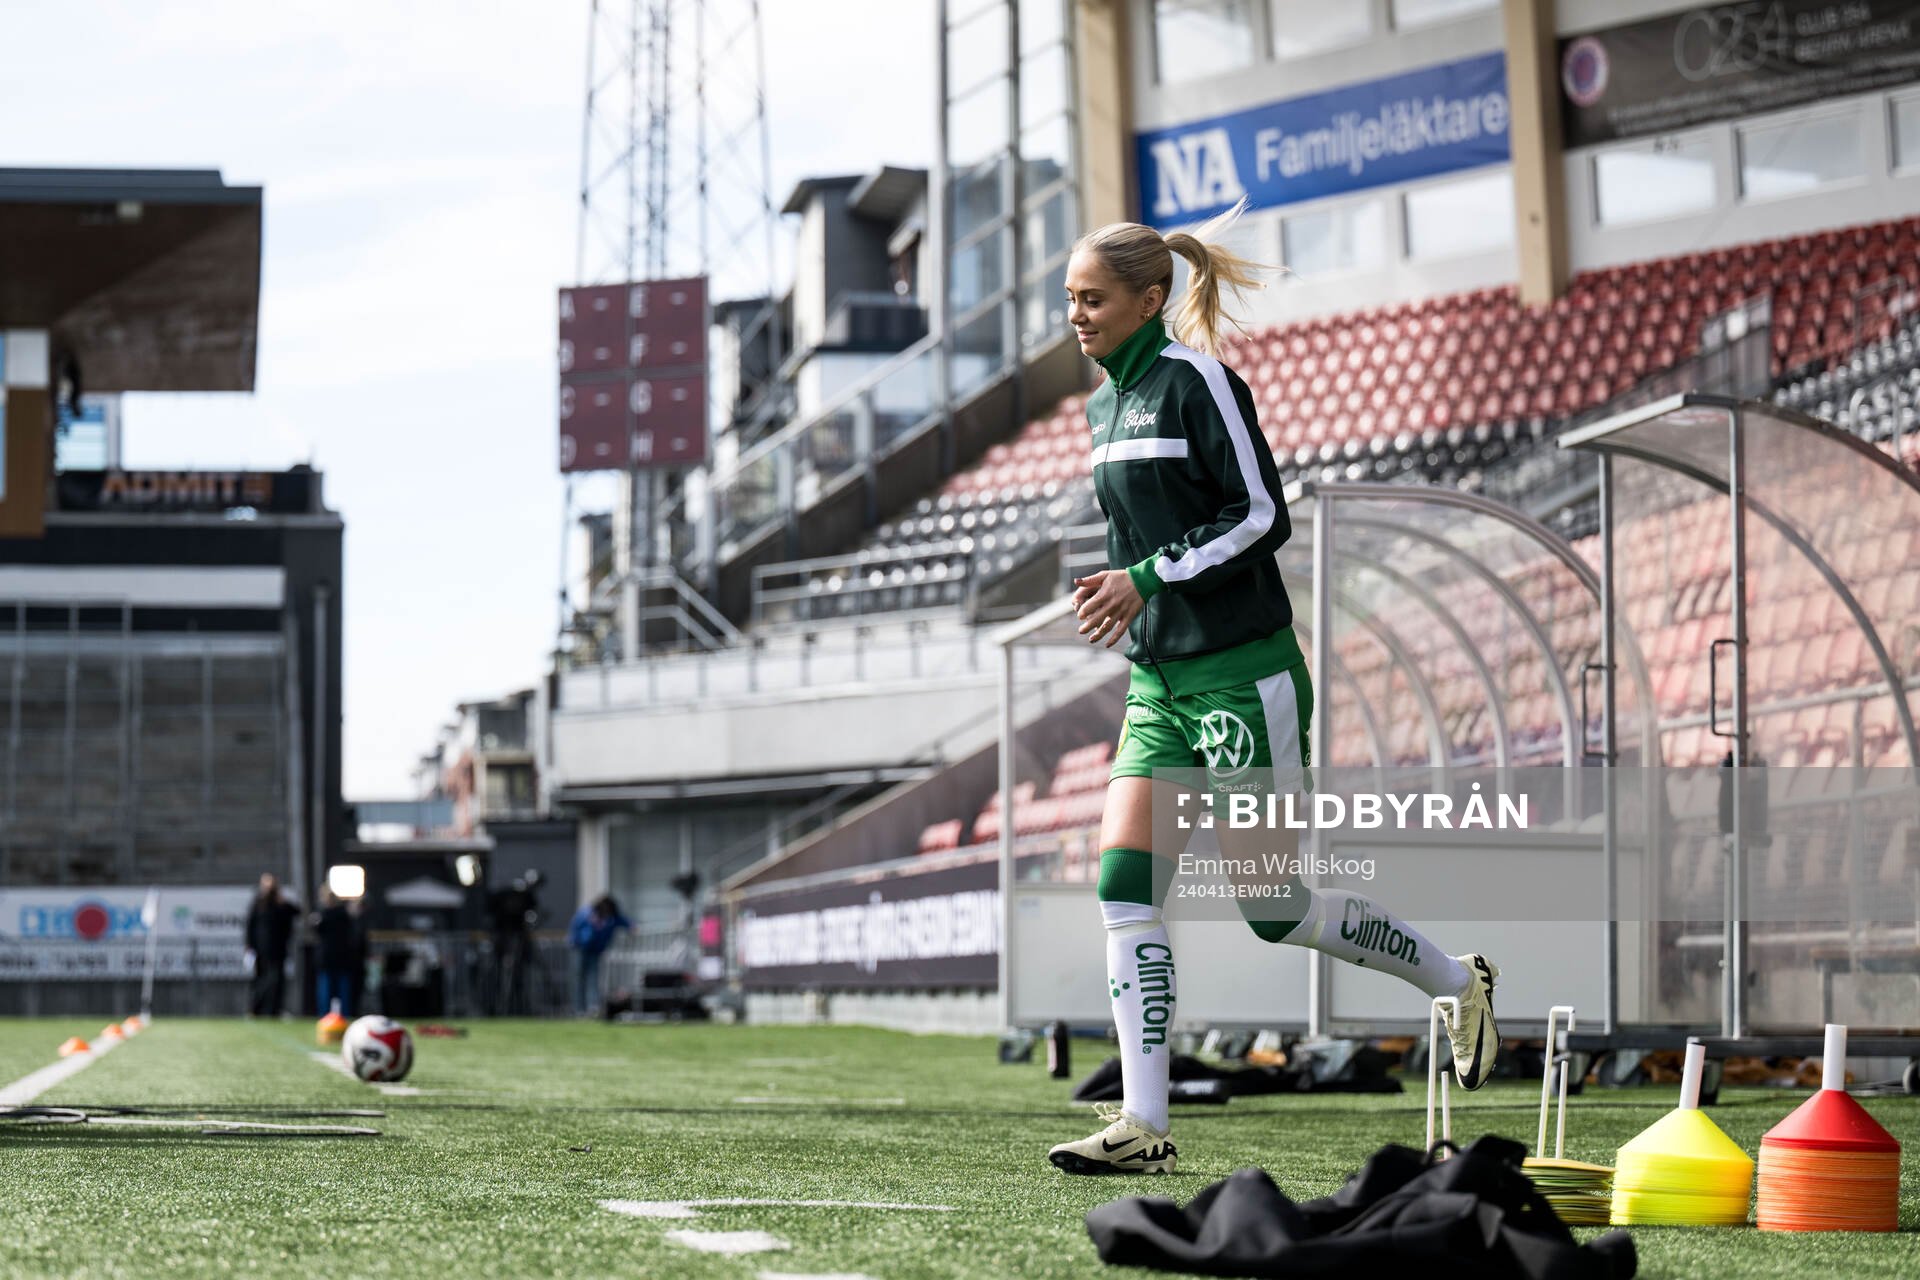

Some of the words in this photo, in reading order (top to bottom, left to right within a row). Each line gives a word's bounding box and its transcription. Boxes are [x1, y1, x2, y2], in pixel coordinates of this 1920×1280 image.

[1150, 127, 1247, 217] NA
[1255, 92, 1508, 183] Familjeläktare
[1124, 408, 1156, 434] Bajen
[1218, 783, 1254, 793] CRAFT
